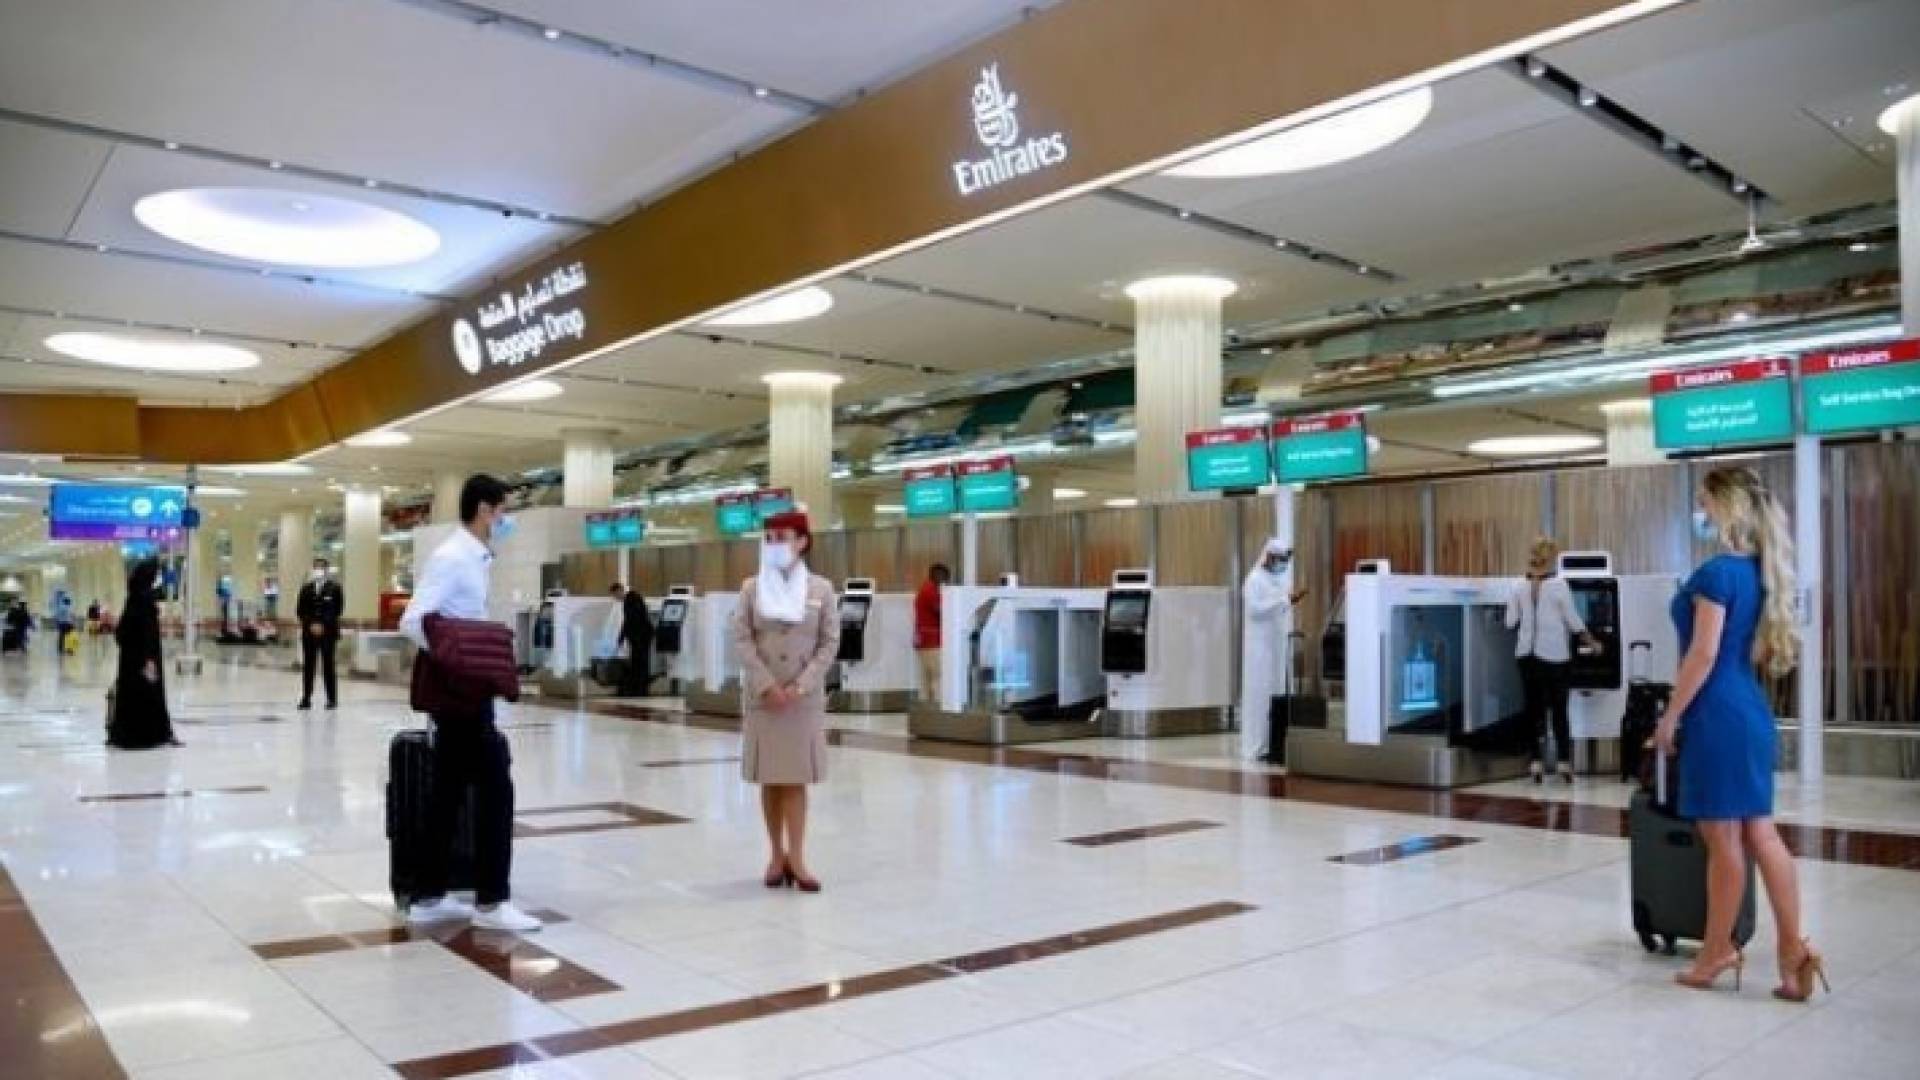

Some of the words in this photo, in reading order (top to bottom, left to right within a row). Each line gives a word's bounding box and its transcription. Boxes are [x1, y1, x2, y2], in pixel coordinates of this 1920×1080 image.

[953, 132, 1067, 195] Emirates
[486, 325, 545, 366] Baggage
[542, 307, 585, 340] Drop
[1676, 367, 1735, 388] Emirates
[1826, 349, 1891, 369] Emirates
